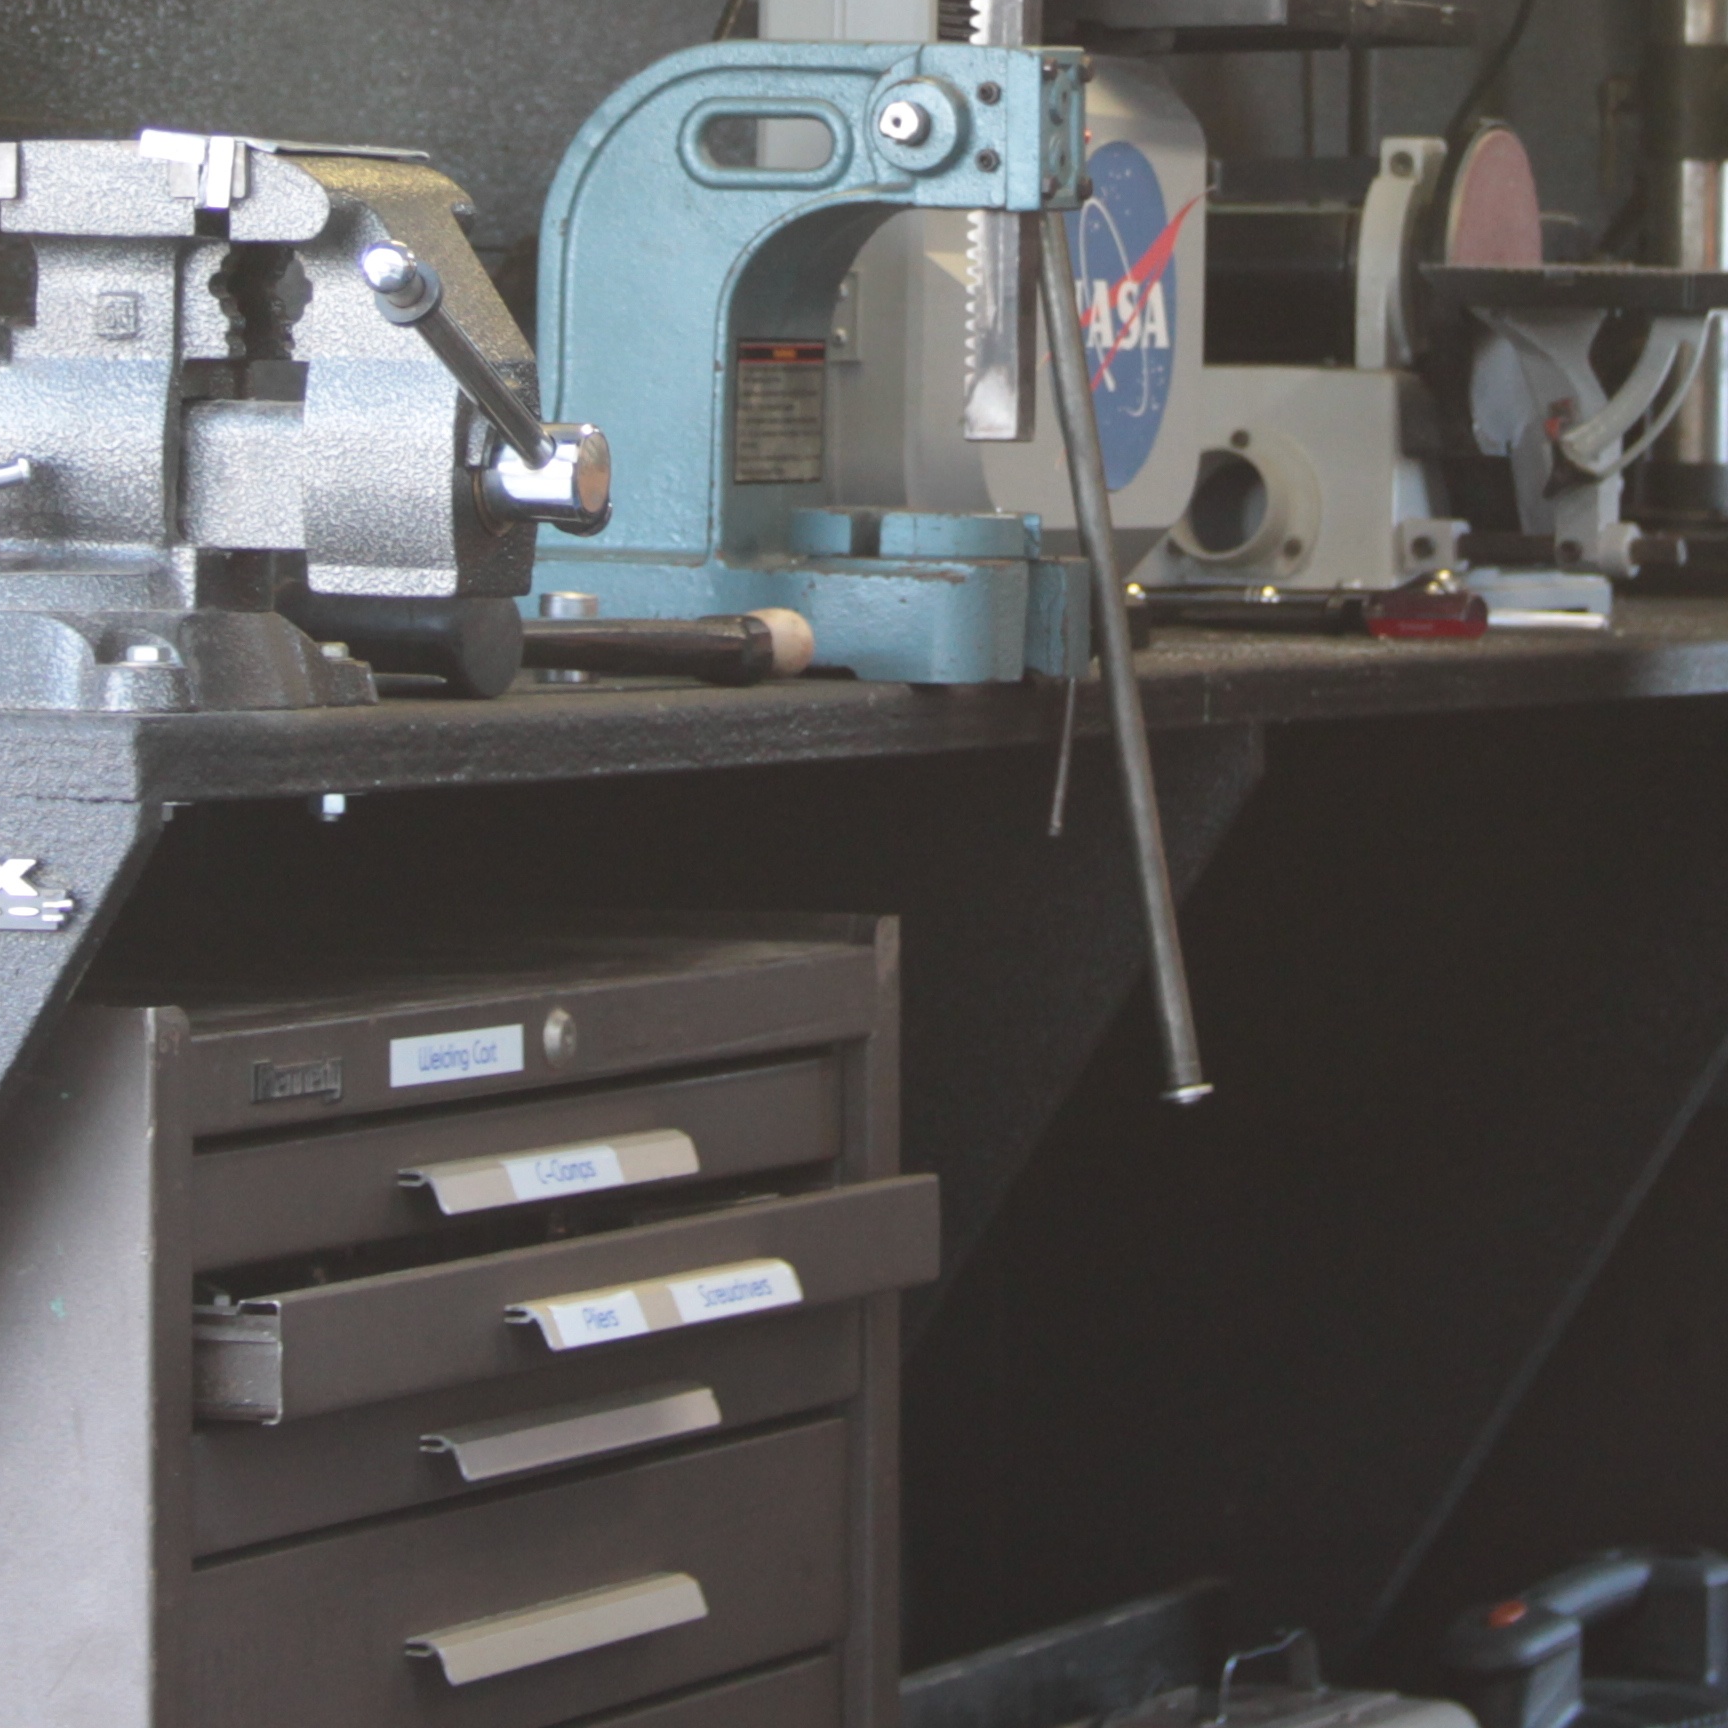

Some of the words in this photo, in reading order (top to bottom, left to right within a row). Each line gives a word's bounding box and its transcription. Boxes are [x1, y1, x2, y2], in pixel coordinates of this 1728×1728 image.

[418, 1045, 470, 1072] Welding
[472, 1039, 499, 1065] Cart
[582, 1306, 620, 1332] Pliers
